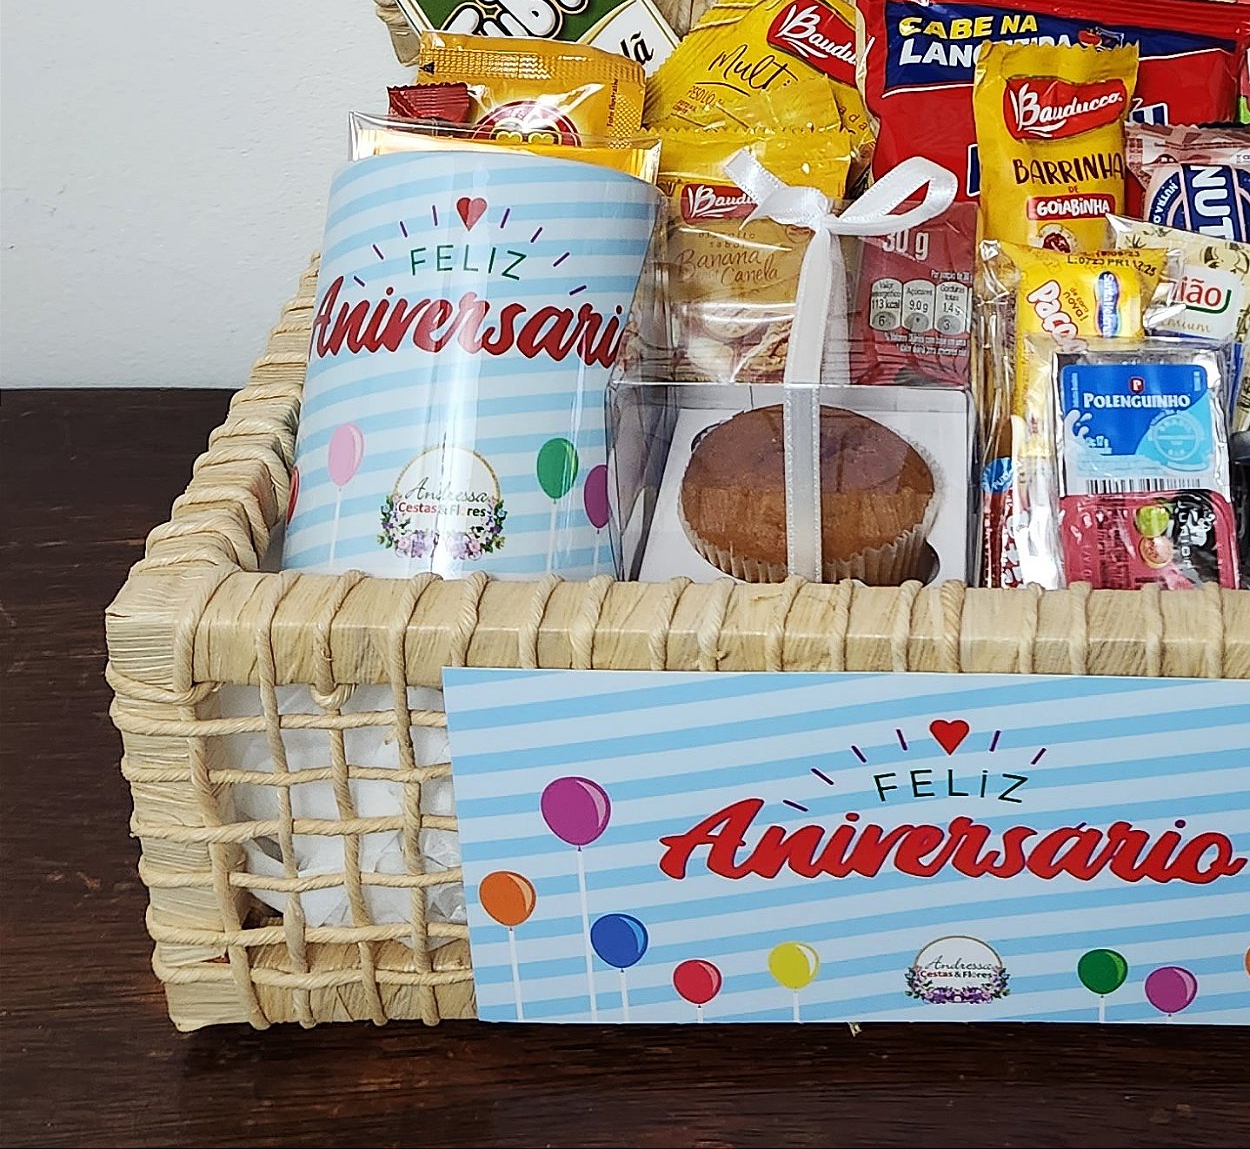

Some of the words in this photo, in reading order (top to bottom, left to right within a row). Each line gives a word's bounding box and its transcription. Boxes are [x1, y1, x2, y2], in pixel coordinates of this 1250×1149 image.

[774, 3, 858, 67] Baudu
[898, 15, 995, 40] CABE
[999, 14, 1038, 36] NA
[707, 43, 799, 92] Mult
[1010, 82, 1122, 137] Bauducco
[1012, 152, 1126, 185] BARRINHA
[687, 184, 755, 219] Baud
[1067, 185, 1080, 194] DE
[1189, 164, 1235, 242] NUT
[409, 243, 528, 281] FELIZ
[914, 231, 929, 261] g
[676, 248, 762, 283] Banana
[720, 253, 781, 286] Canela
[1062, 291, 1090, 322] nova!
[1172, 276, 1223, 307] ião
[308, 275, 624, 370] Aniversari
[1026, 279, 1089, 353] Paço
[1083, 392, 1191, 409] POLENGUINHO
[404, 476, 489, 503] Andressa
[398, 501, 437, 514] Cestas
[448, 503, 487, 517] Flres
[658, 798, 1249, 884] Aniversário
[920, 970, 953, 979] Cestas
[925, 954, 993, 971] Andressa
